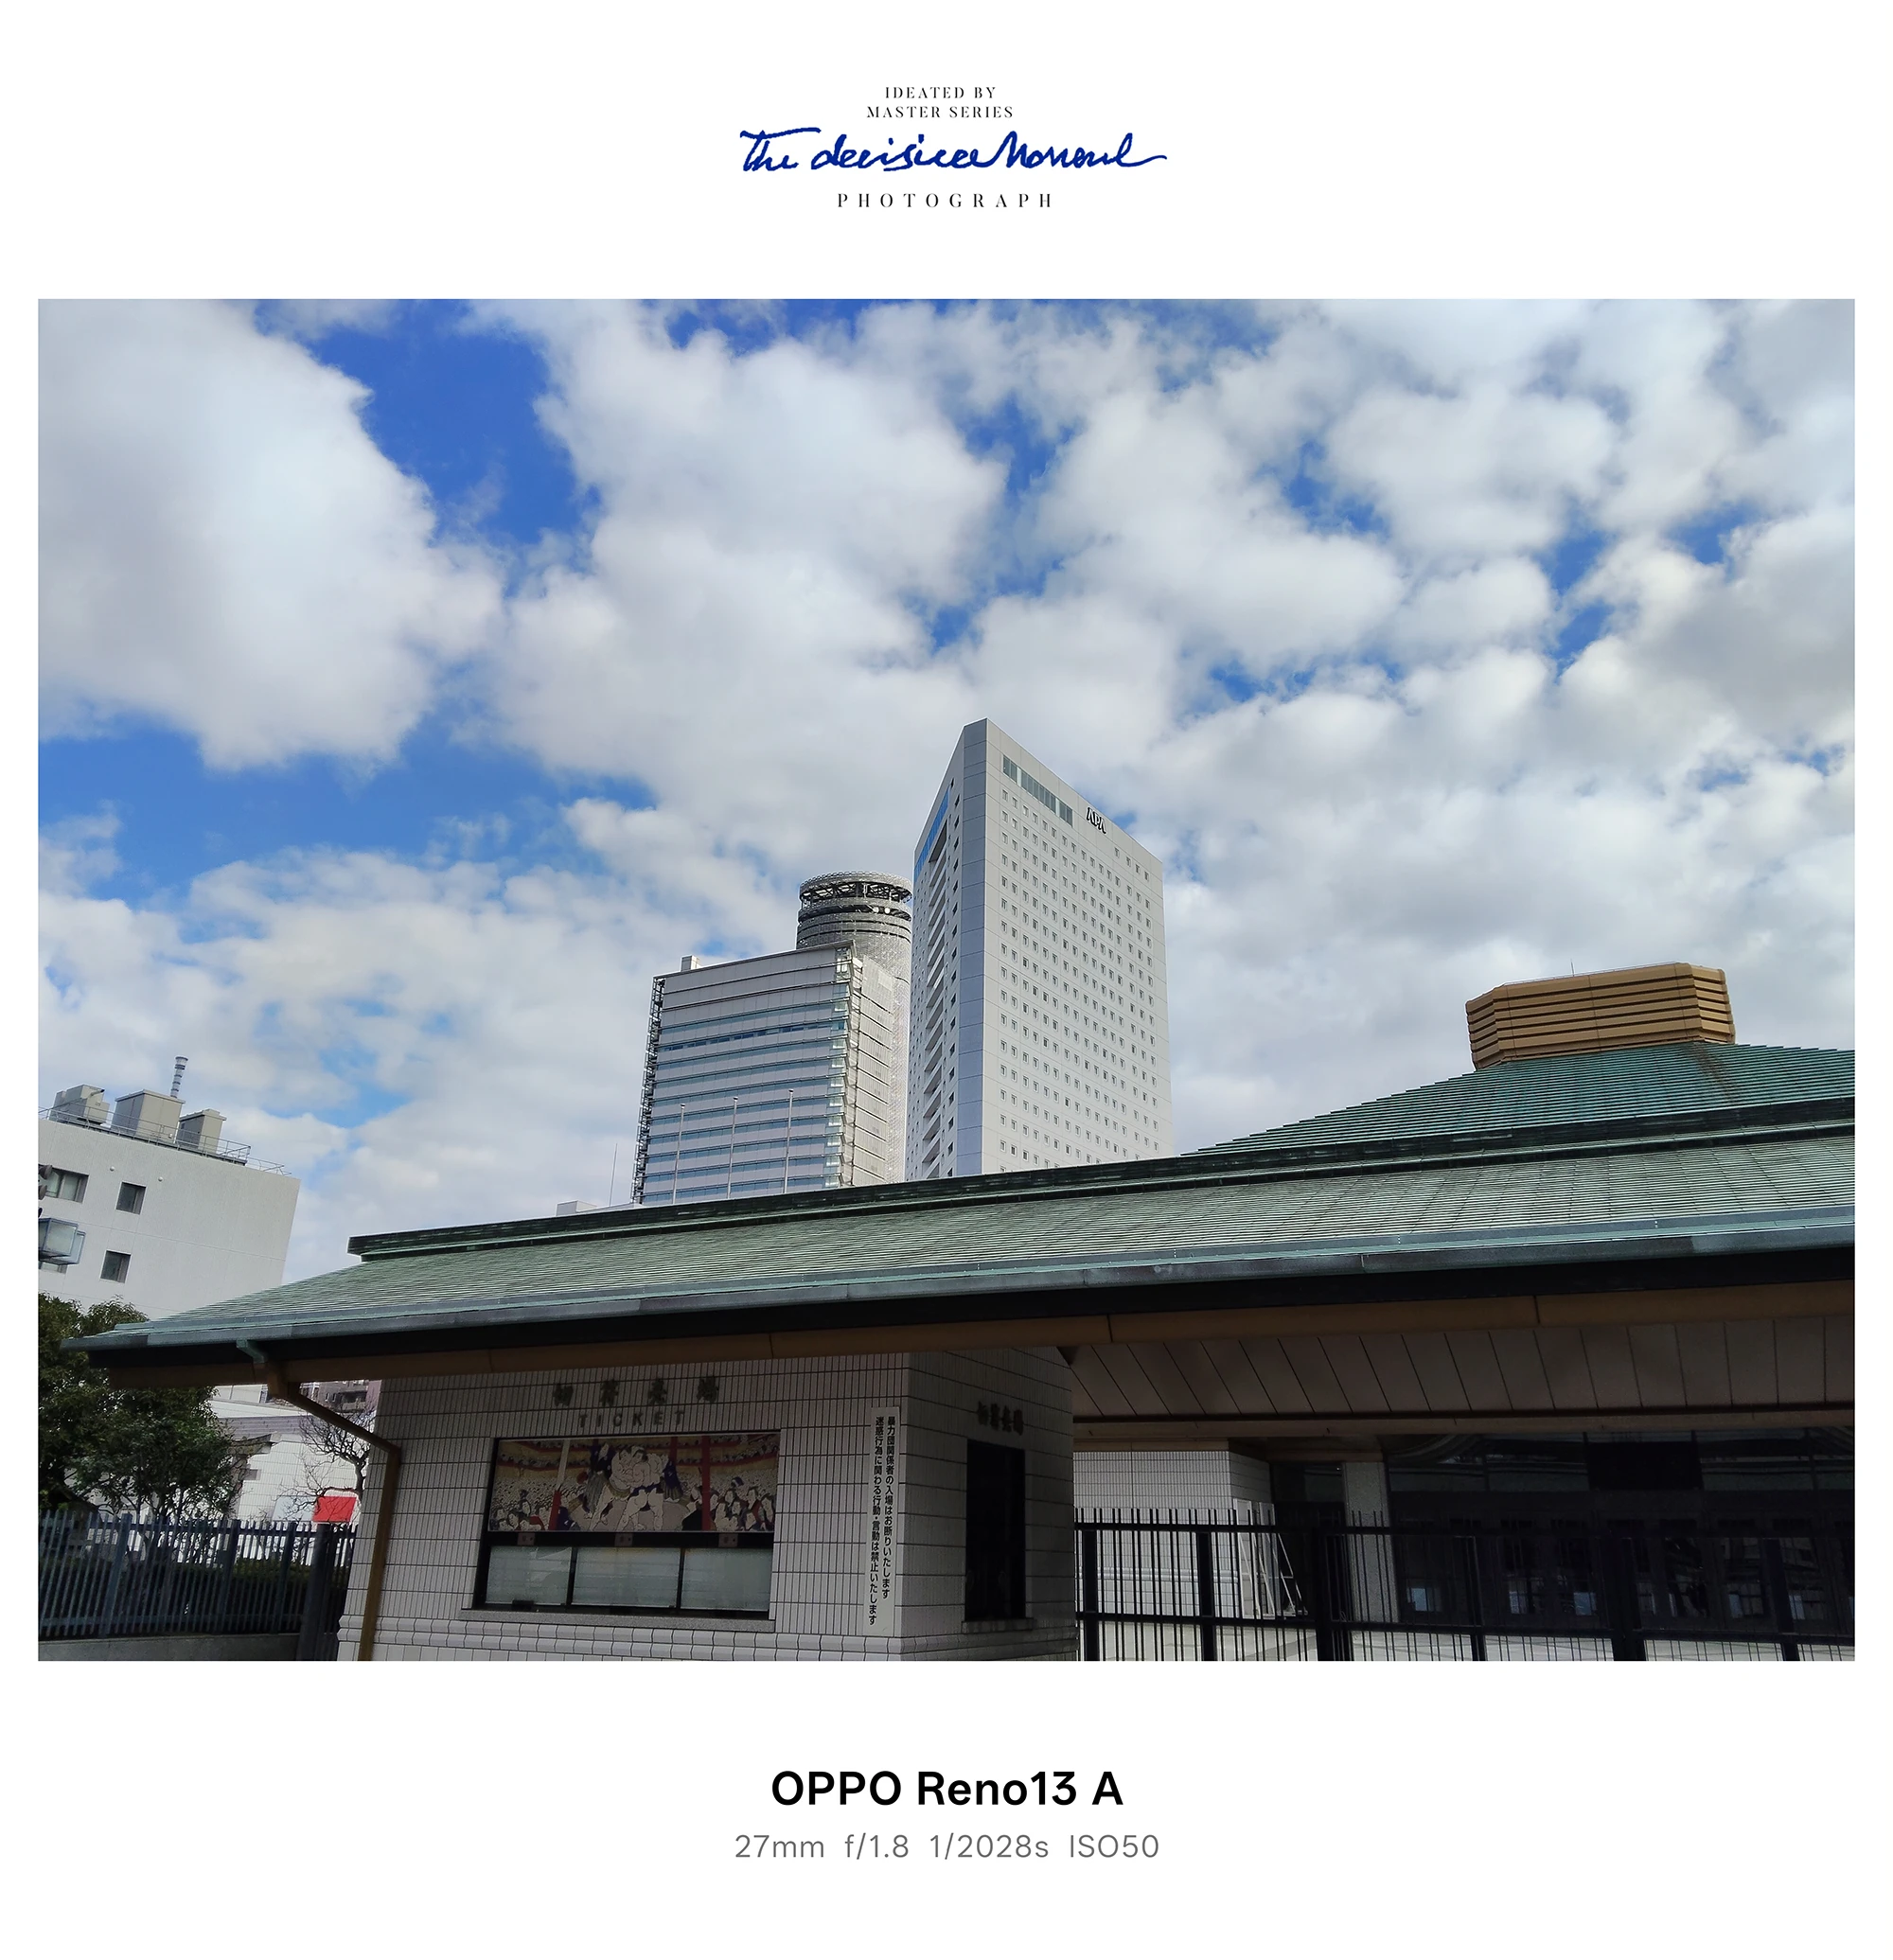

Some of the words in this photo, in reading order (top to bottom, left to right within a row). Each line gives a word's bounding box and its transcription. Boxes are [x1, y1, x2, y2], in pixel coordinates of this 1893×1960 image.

[1086, 806, 1107, 834] APA
[578, 1410, 685, 1427] TICKET
[869, 1416, 884, 1625] 迷惑行為に関わる行動・言動は禁止いたします
[881, 1416, 895, 1598] 暴力団関係者の入場はお断りいたします
